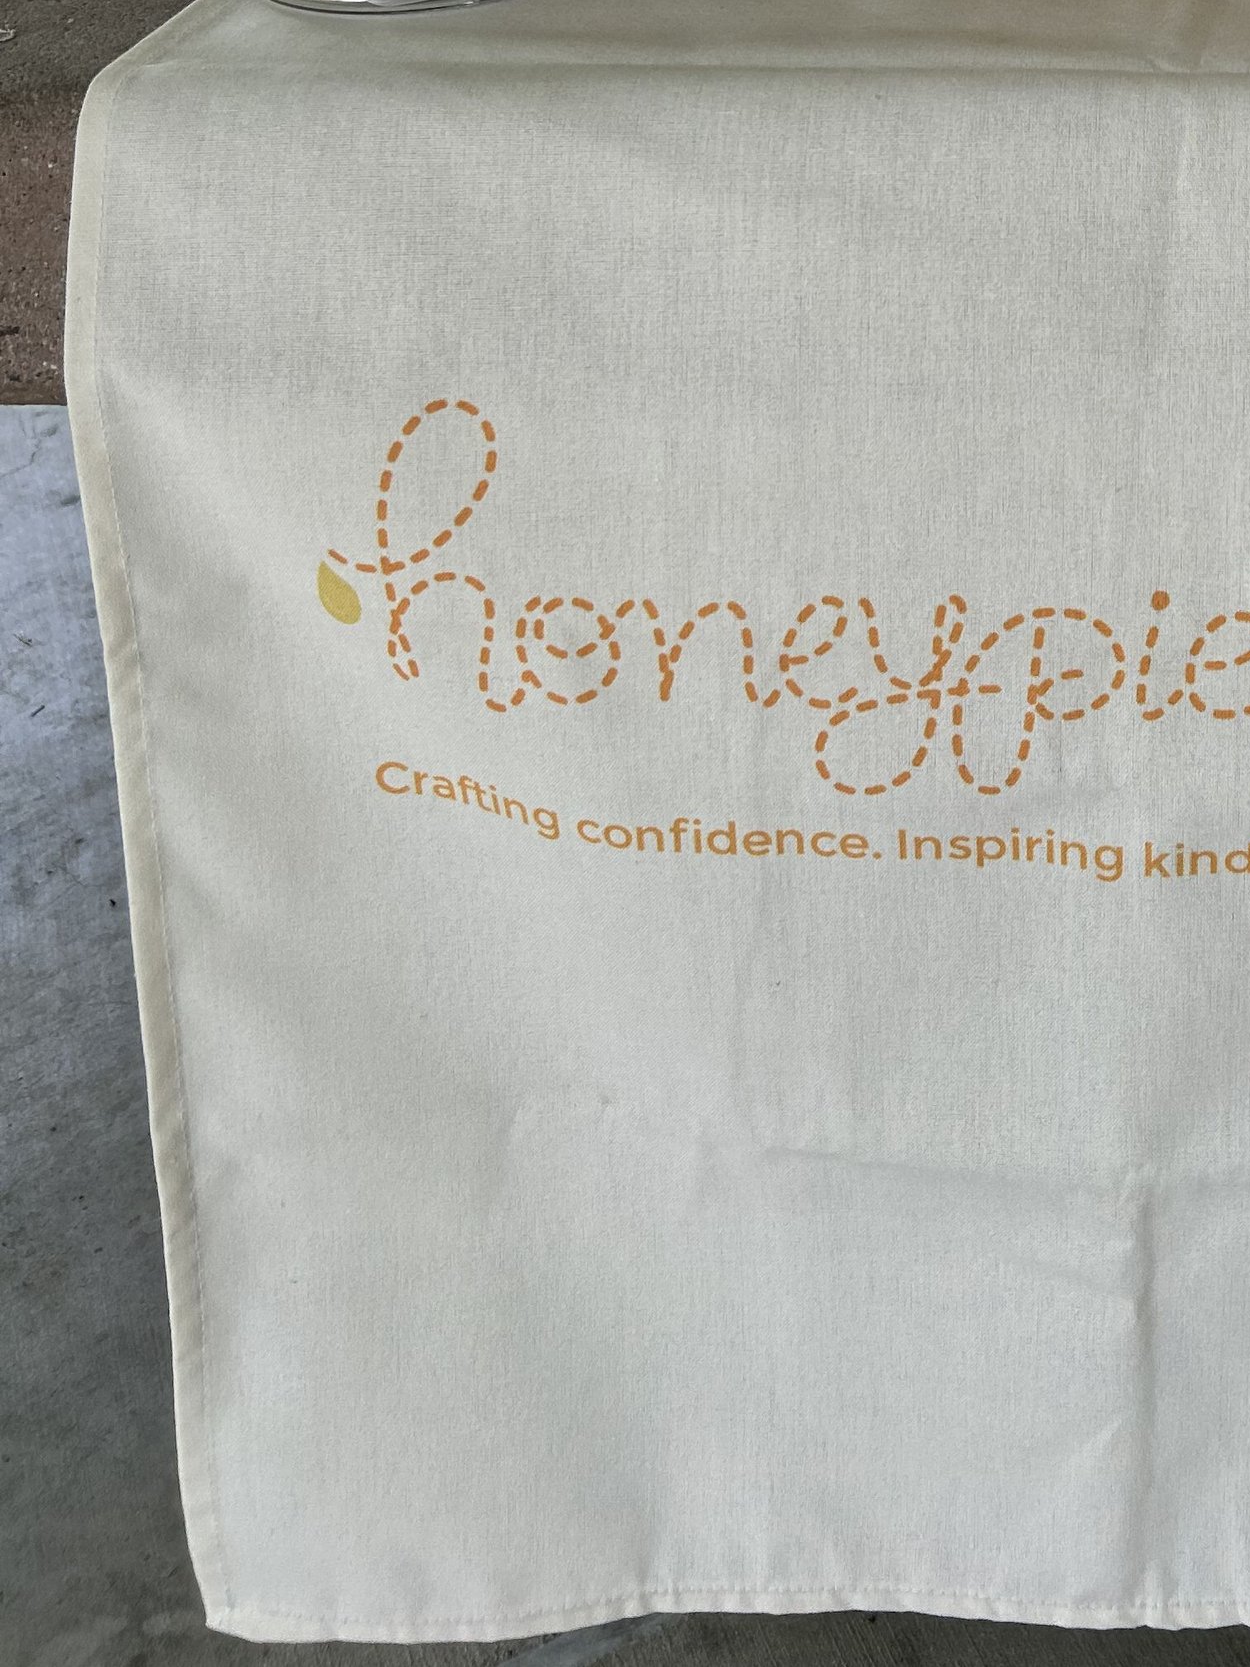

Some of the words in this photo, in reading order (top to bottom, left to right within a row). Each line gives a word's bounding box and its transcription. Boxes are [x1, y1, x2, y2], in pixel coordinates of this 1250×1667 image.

[373, 760, 560, 841] Crafting
[576, 817, 883, 861] confidence.
[896, 826, 1125, 883] Inspiring
